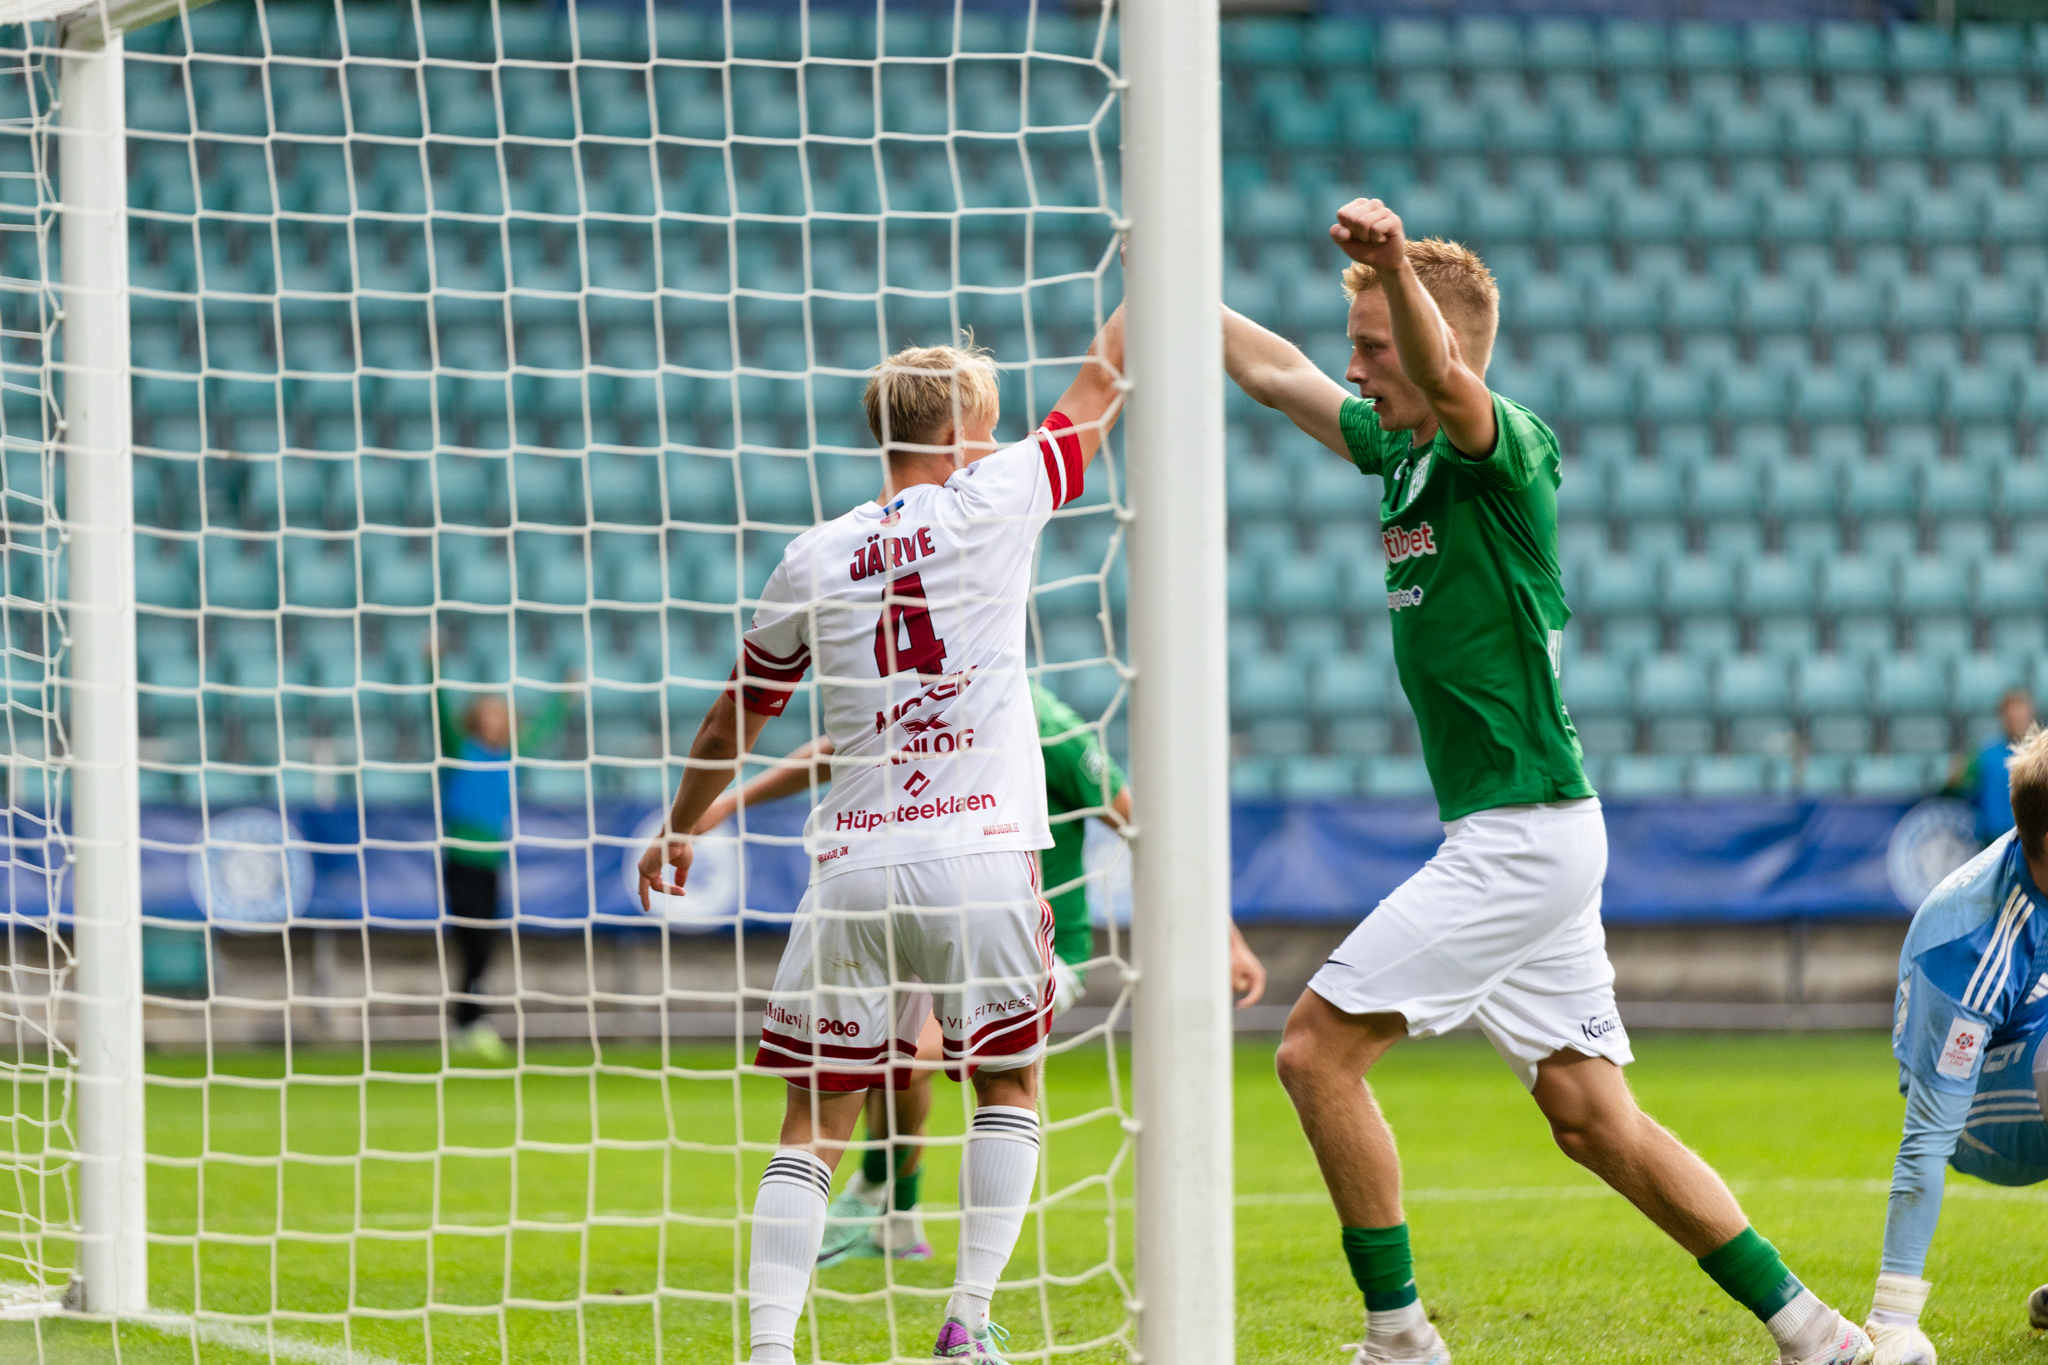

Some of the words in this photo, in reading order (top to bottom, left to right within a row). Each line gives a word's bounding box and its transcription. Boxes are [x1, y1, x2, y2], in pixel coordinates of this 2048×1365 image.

[850, 525, 936, 581] JÄRVE
[1384, 523, 1435, 558] tibet
[874, 571, 947, 688] 4
[836, 793, 996, 833] Hüpoteeklaen
[818, 1020, 858, 1036] PLG
